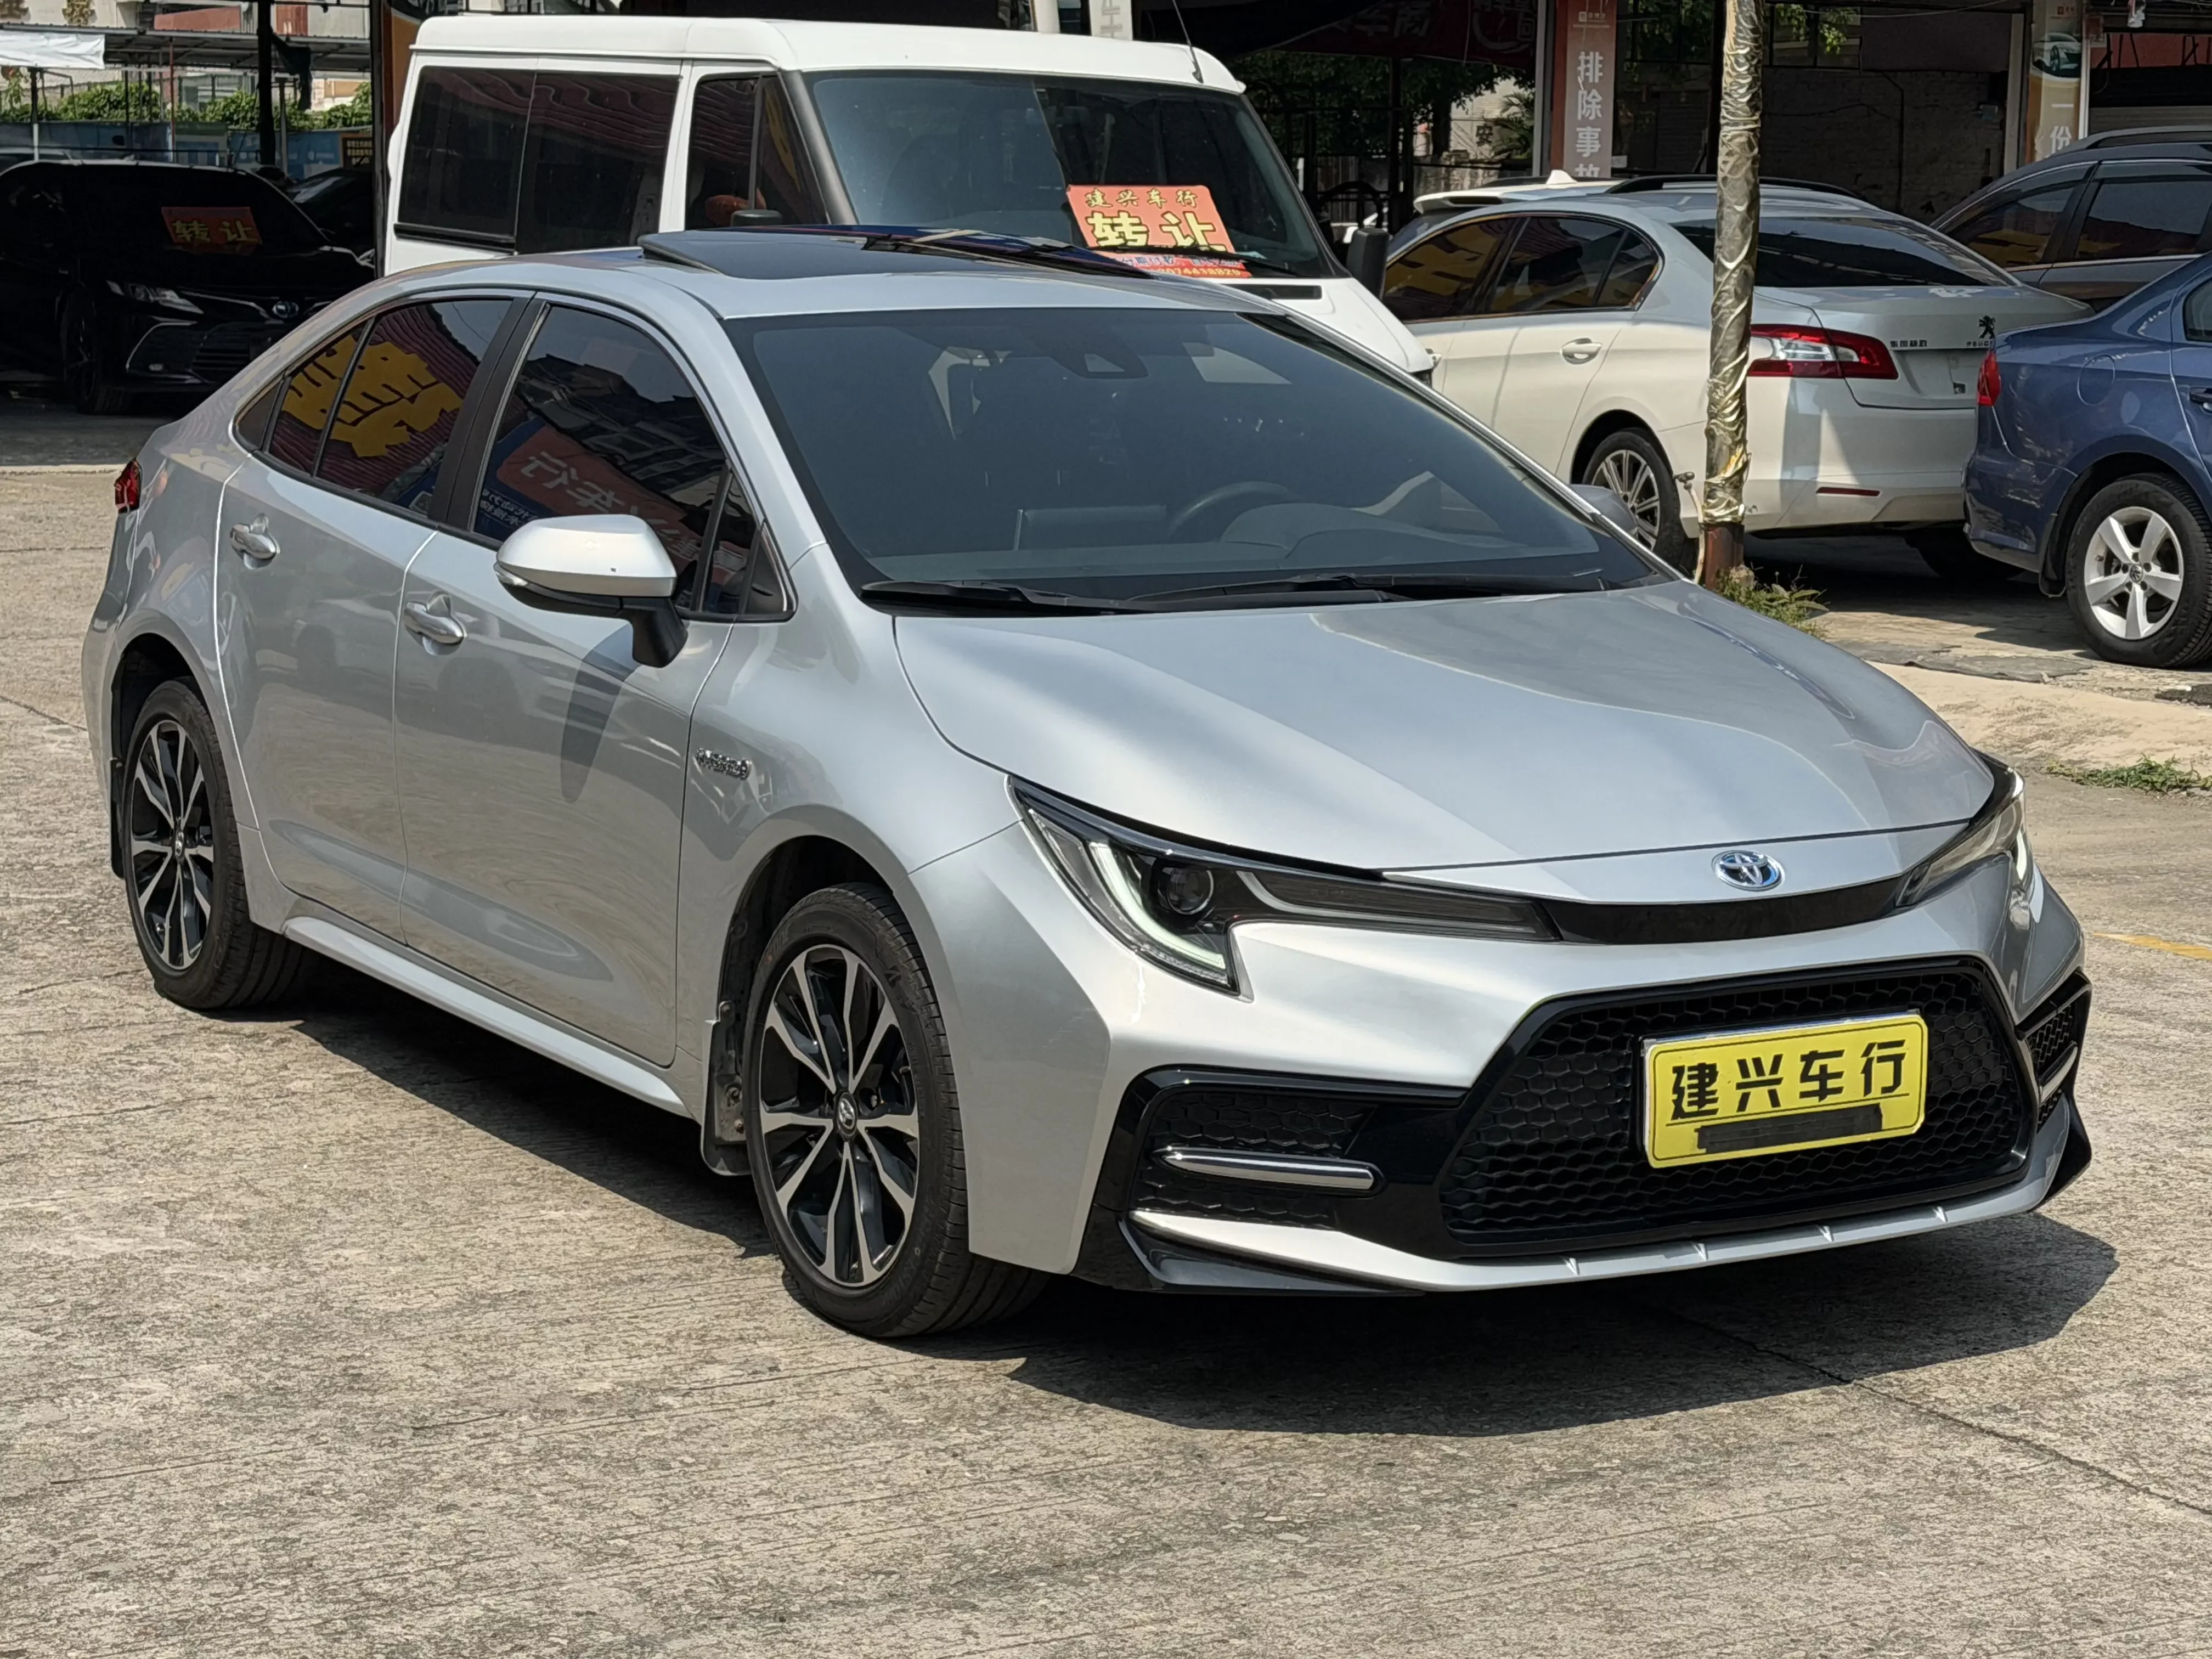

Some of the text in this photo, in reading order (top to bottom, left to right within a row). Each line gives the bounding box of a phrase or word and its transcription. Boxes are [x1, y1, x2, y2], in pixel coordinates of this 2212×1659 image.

[1084, 188, 1198, 208] 建兴车行
[172, 220, 259, 242] 转让
[1085, 210, 1226, 252] 转让
[1671, 1040, 1906, 1120] 建兴车行
